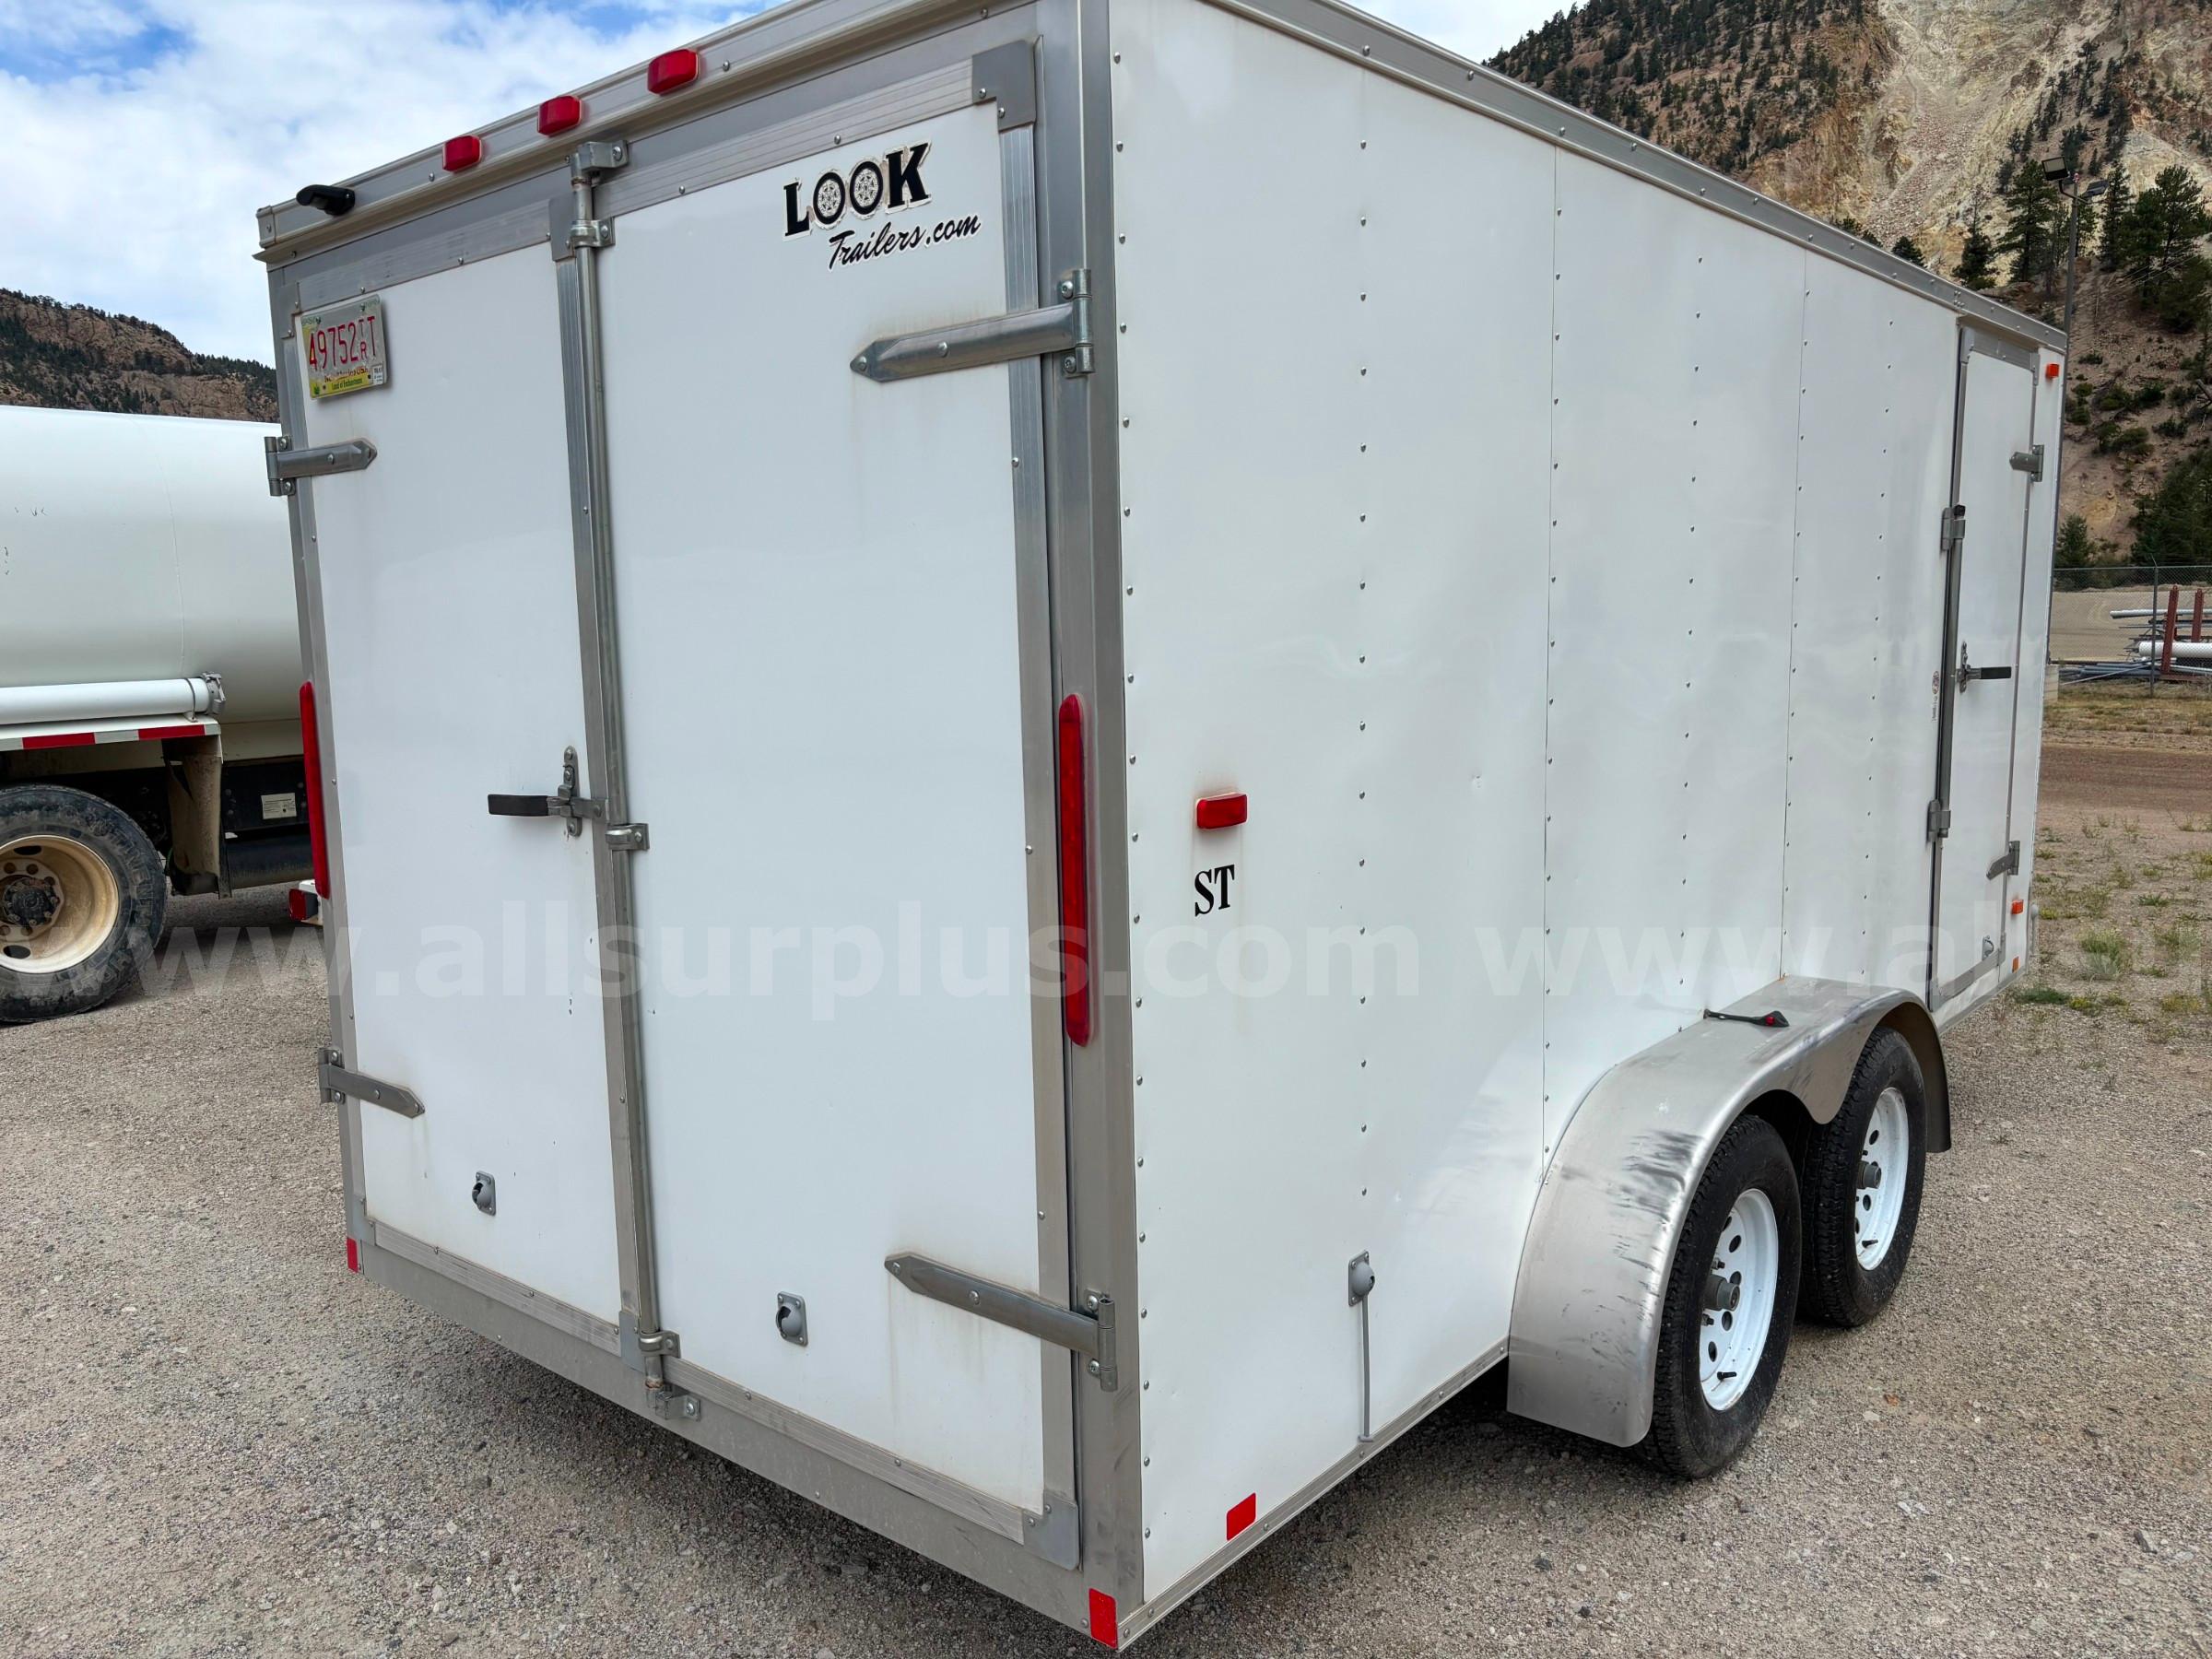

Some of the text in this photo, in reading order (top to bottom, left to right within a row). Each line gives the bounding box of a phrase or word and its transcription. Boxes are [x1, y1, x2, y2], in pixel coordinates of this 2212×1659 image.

[783, 142, 931, 237] LOOK
[829, 215, 982, 270] Trailers.com
[1194, 865, 1235, 917] ST
